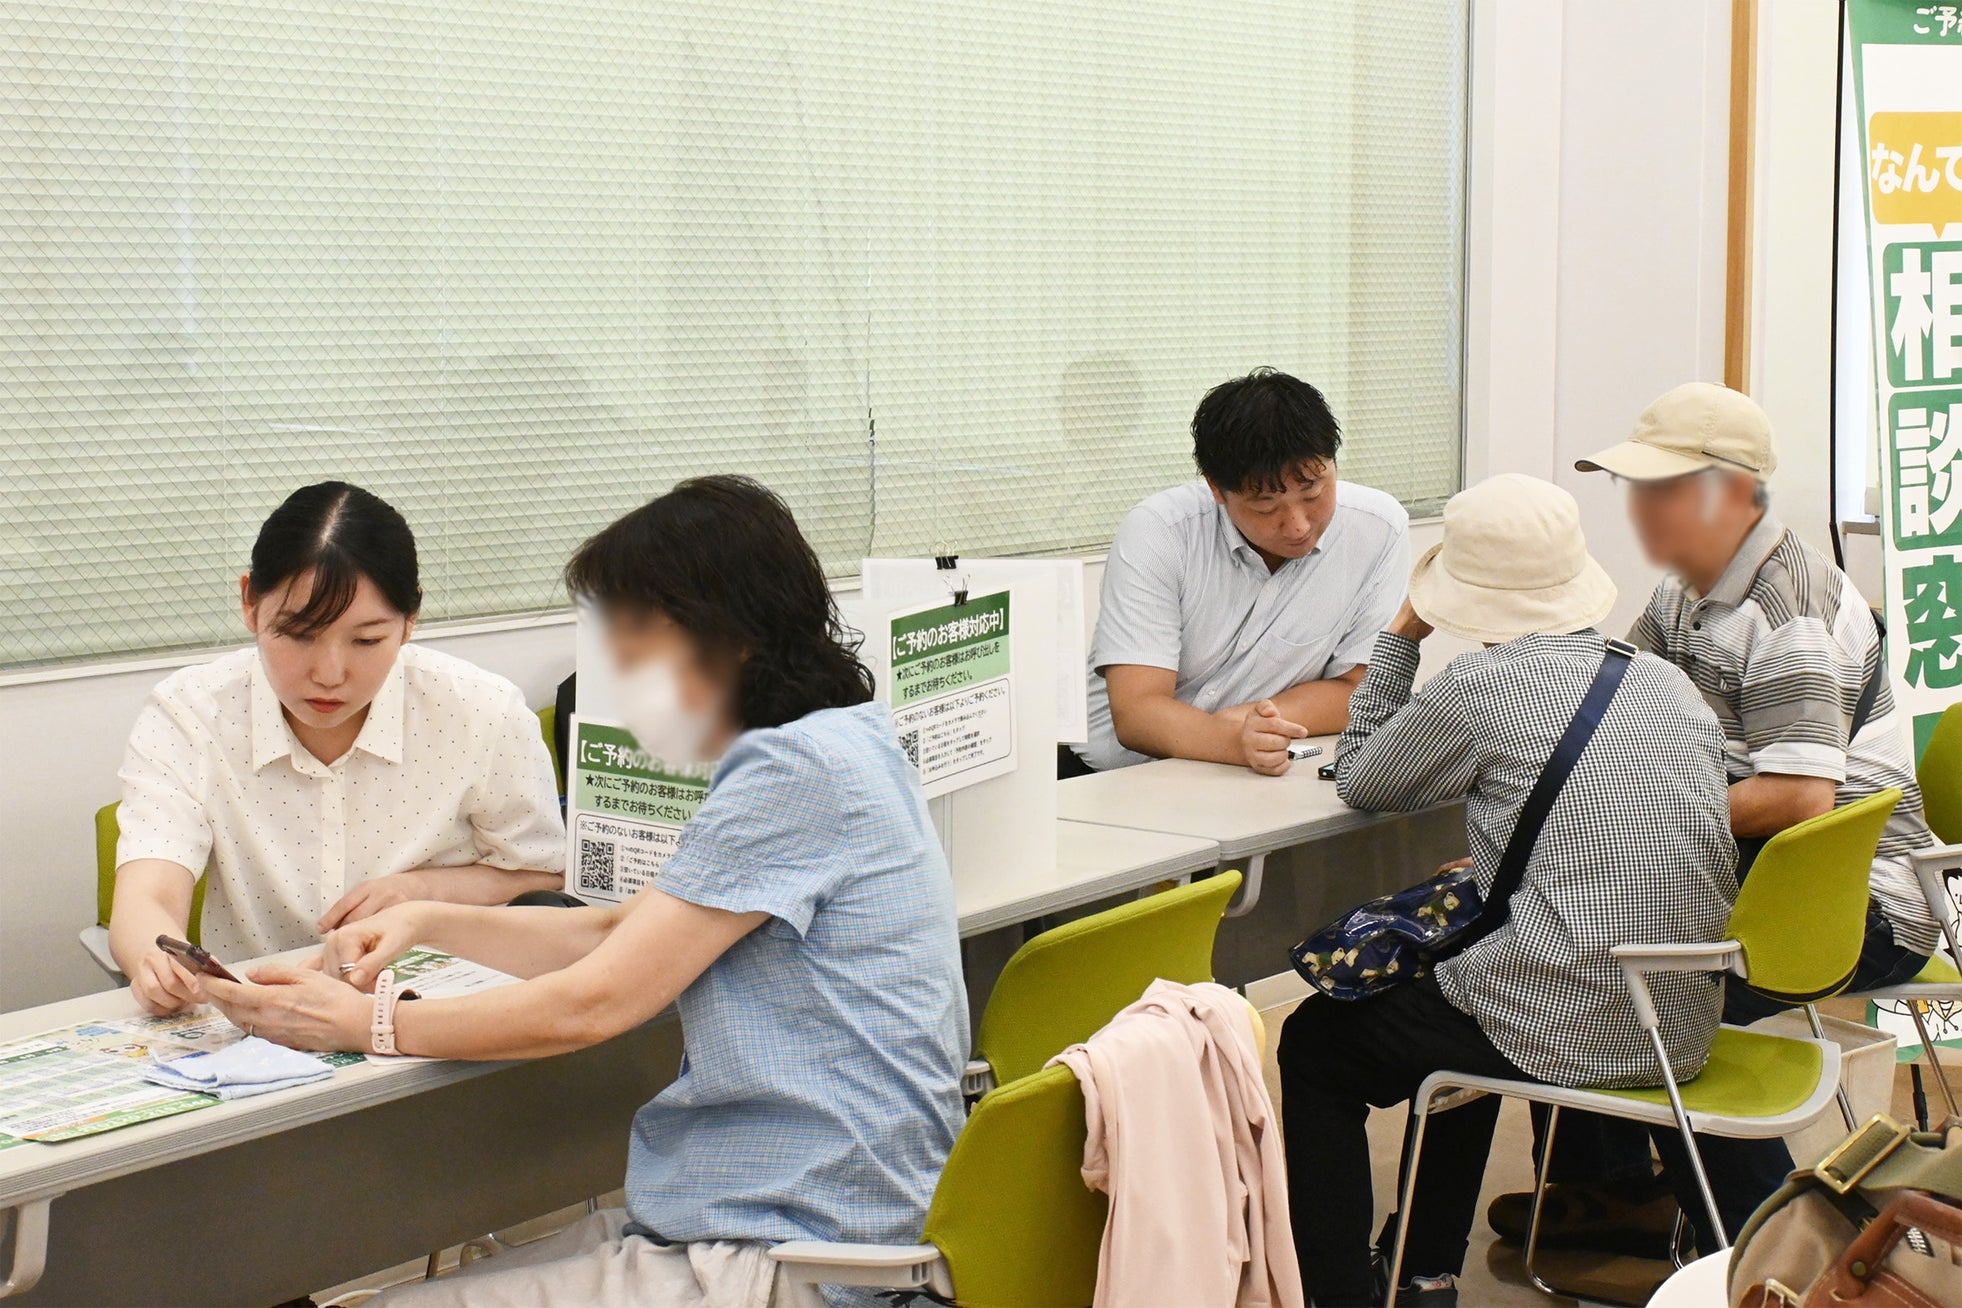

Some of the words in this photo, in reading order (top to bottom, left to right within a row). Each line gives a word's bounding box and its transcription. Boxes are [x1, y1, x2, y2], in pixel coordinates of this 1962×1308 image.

[892, 608, 1004, 660] 【ご予約のお客様対応中】
[1890, 247, 1962, 776] 相談窓
